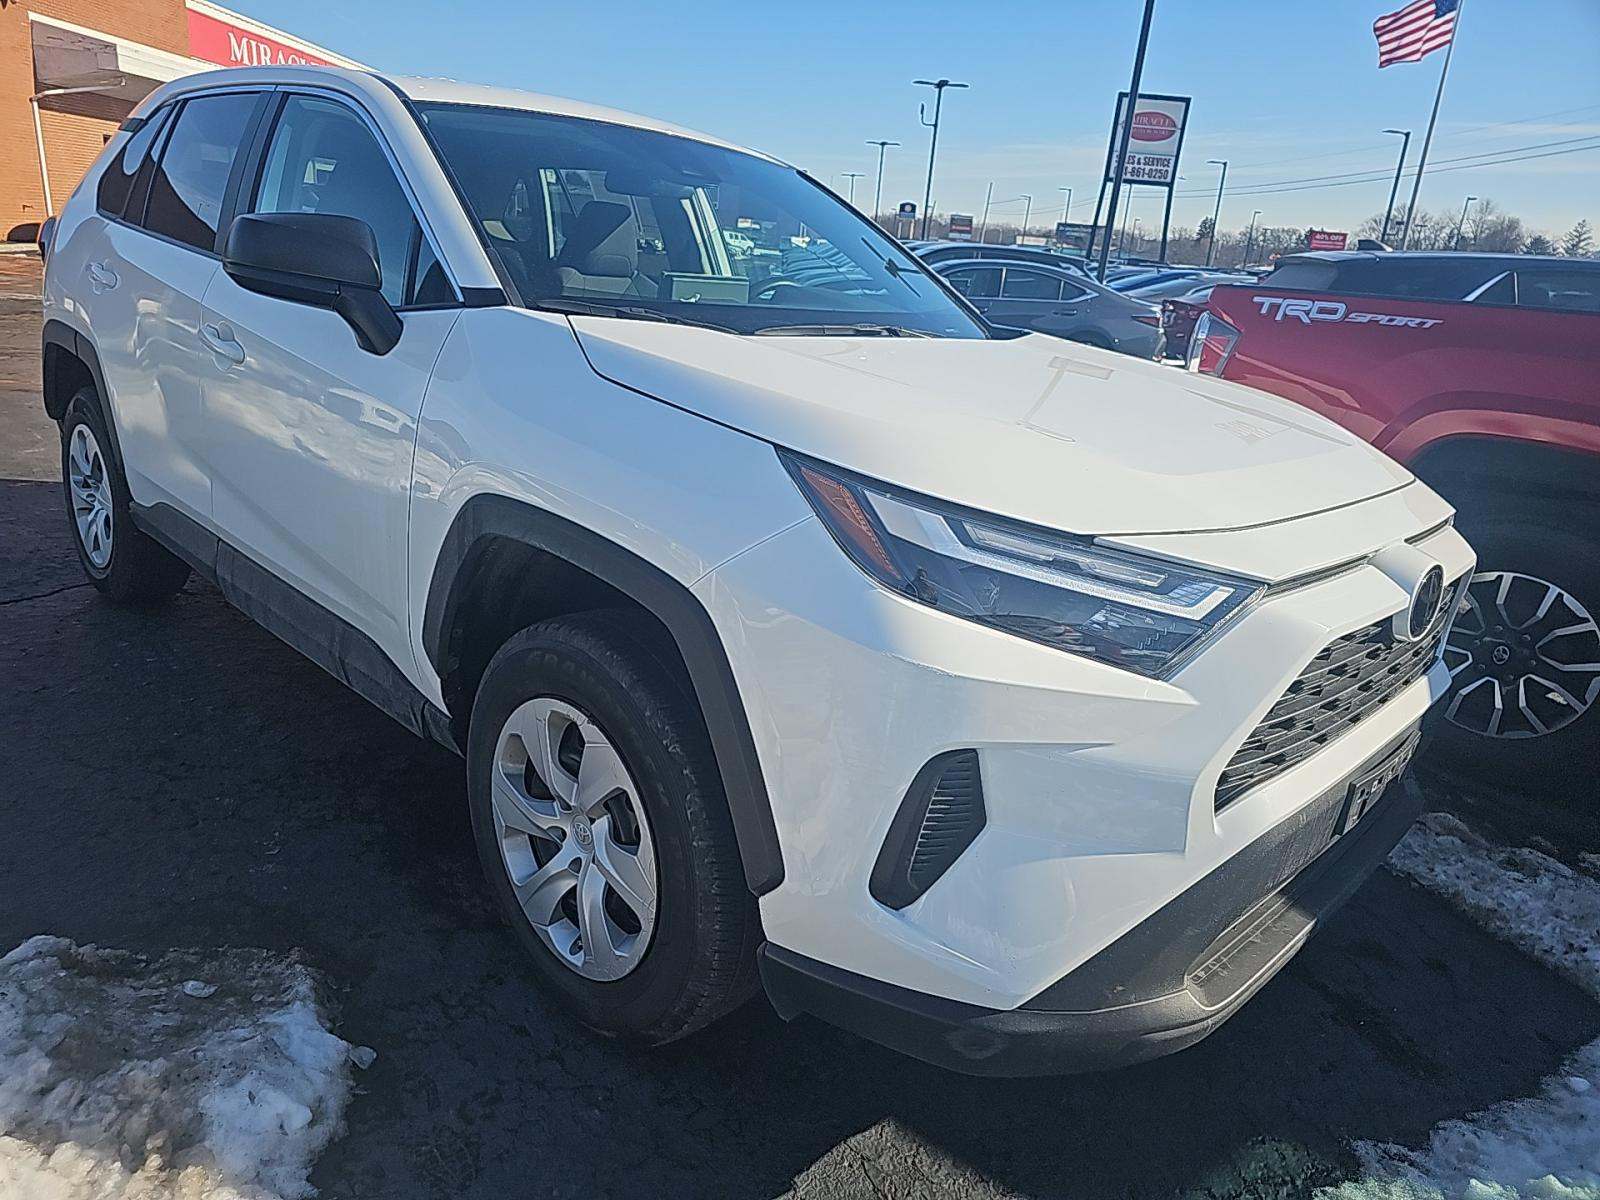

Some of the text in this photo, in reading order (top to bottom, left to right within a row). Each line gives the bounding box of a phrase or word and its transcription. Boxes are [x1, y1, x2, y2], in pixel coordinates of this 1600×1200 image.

[228, 32, 319, 66] MIRA
[1143, 156, 1172, 168] SERVICE
[1253, 296, 1444, 329] TRD SPORT
